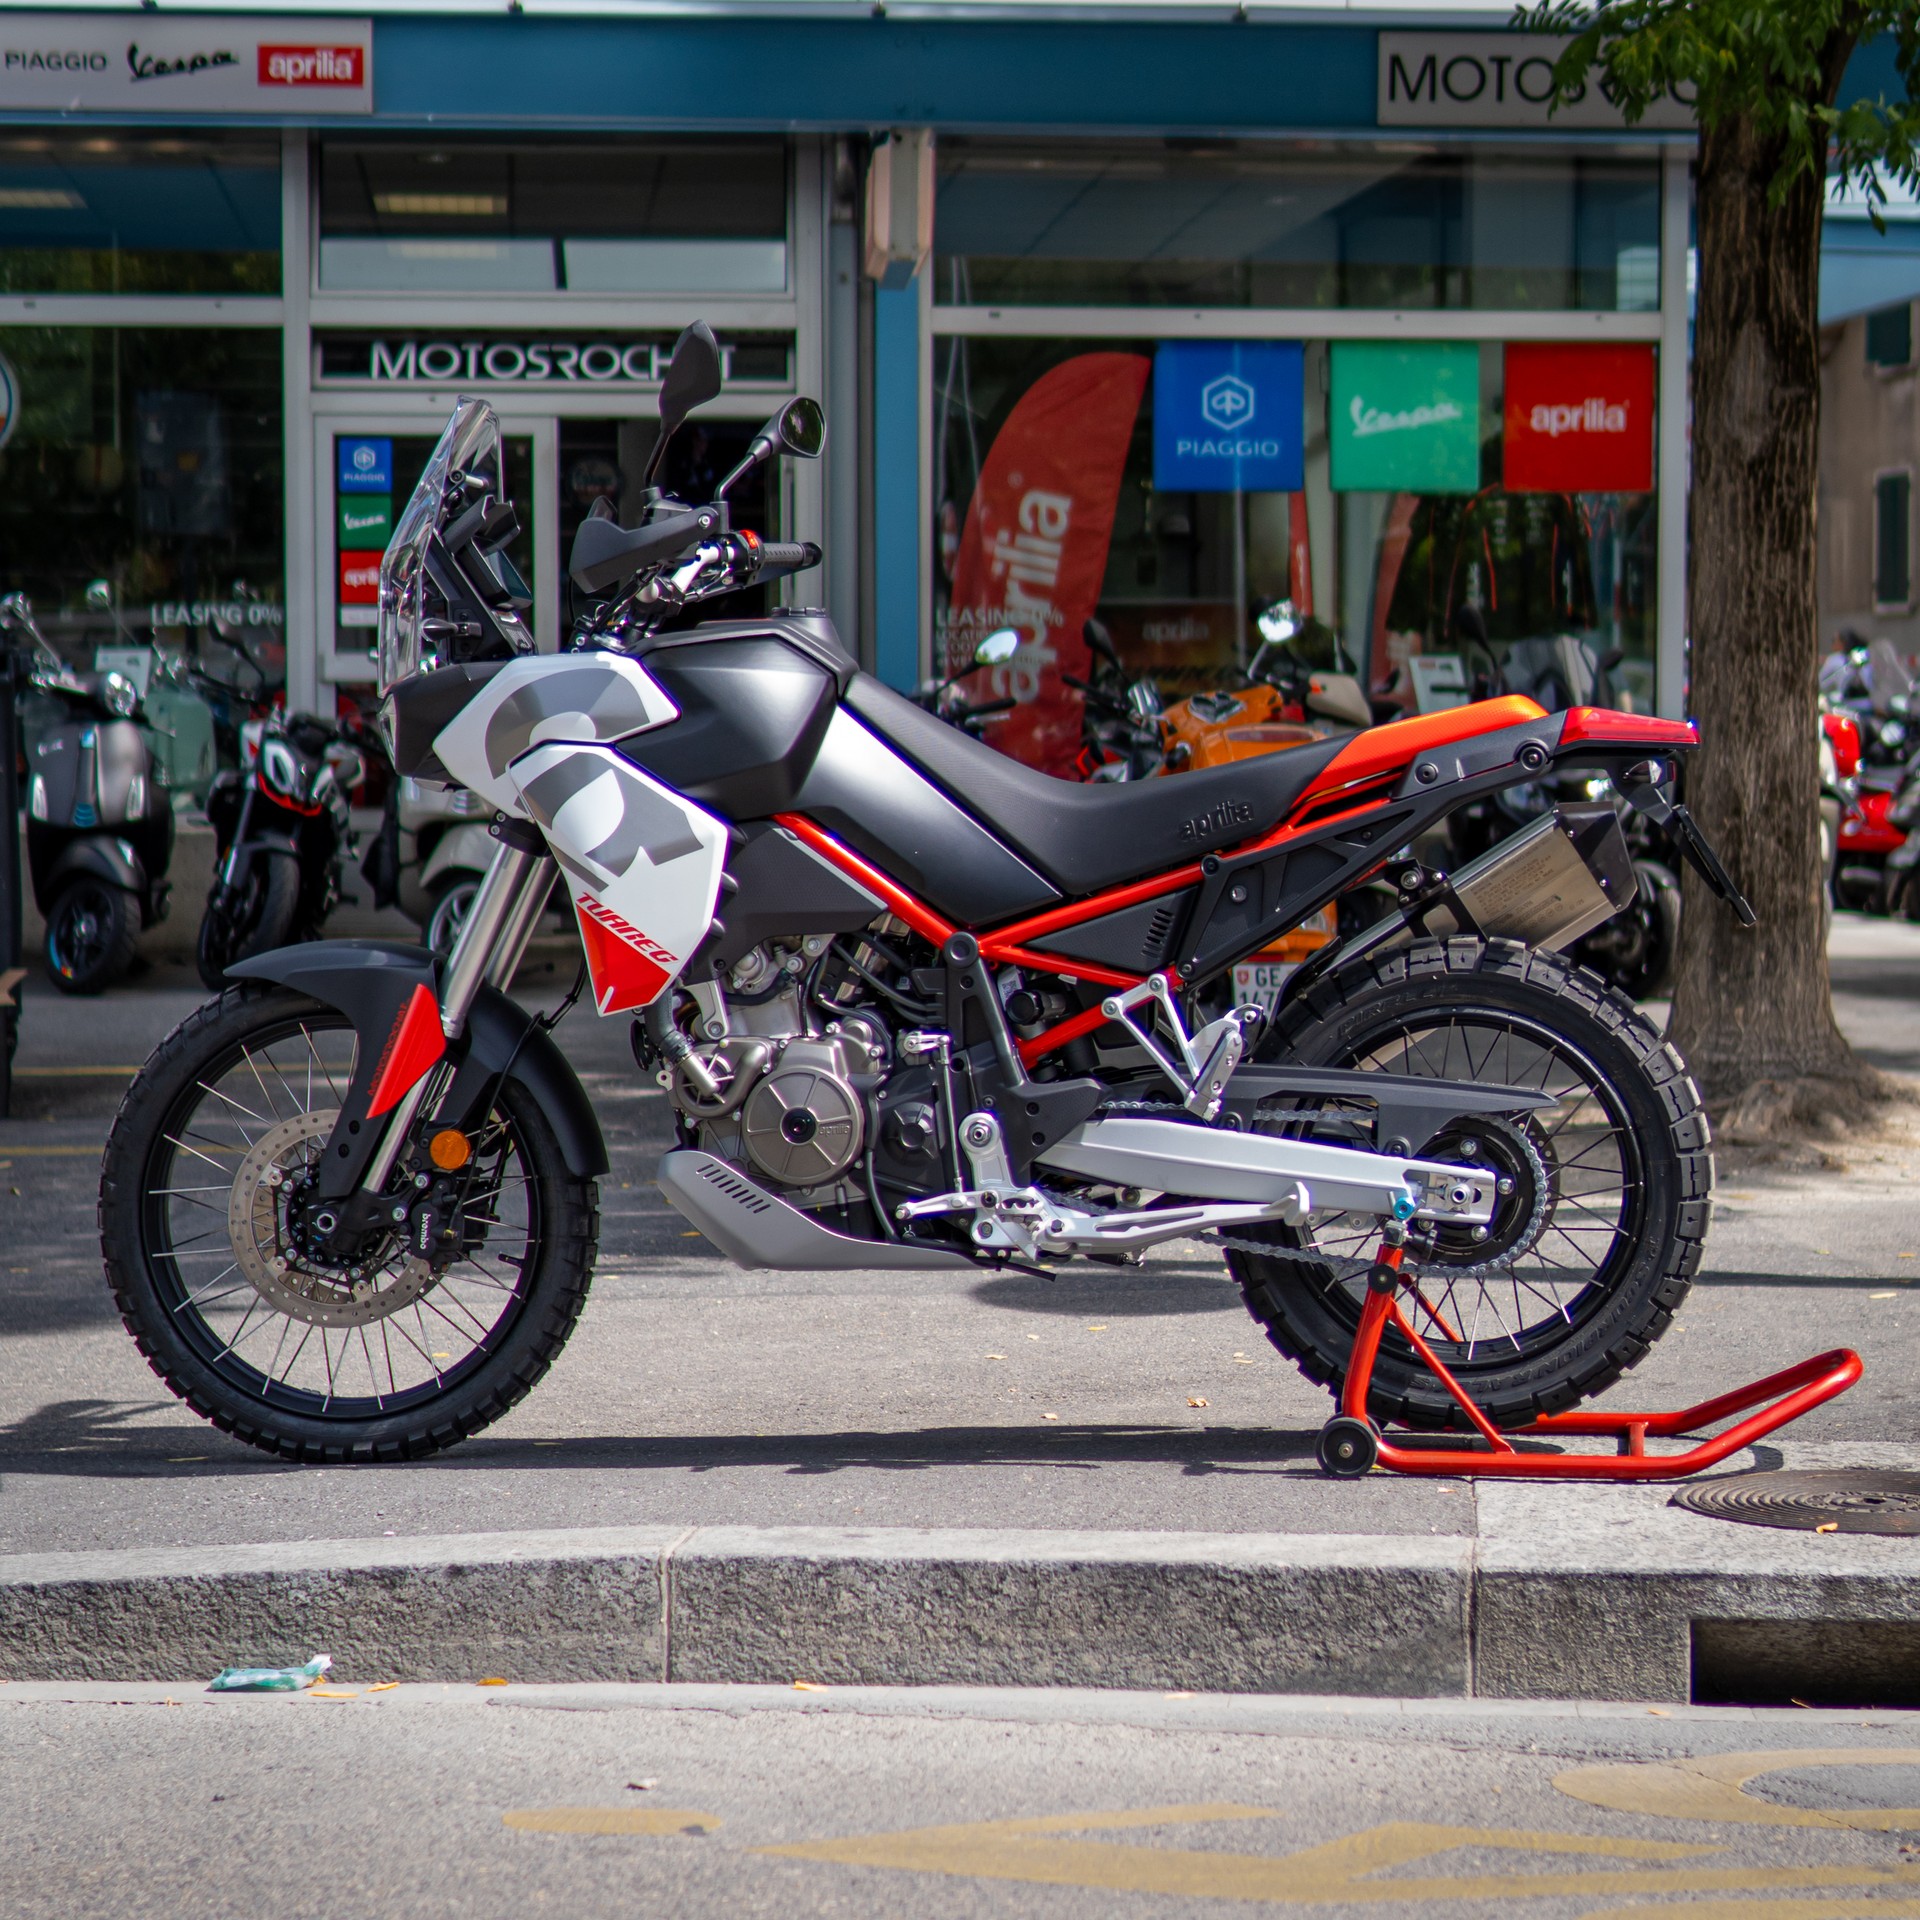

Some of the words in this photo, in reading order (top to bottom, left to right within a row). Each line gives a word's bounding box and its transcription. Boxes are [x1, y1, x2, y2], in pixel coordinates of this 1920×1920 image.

[4, 51, 107, 72] PIAGGIO
[126, 42, 239, 82] Vespa
[268, 52, 353, 82] aprilia
[370, 342, 736, 380] MOTOSROCHT
[1350, 396, 1461, 436] Vespa
[1530, 398, 1627, 435] aprilia
[1177, 440, 1279, 457] PIAGGIO
[343, 473, 386, 482] PIAGGIO
[991, 489, 1072, 703] aprilia
[152, 604, 242, 626] LEASING
[250, 605, 283, 625] 0%
[1181, 801, 1255, 842] aprilia
[576, 892, 679, 963] TUAREG
[1256, 967, 1281, 987] GE
[420, 1213, 431, 1249] brembo
